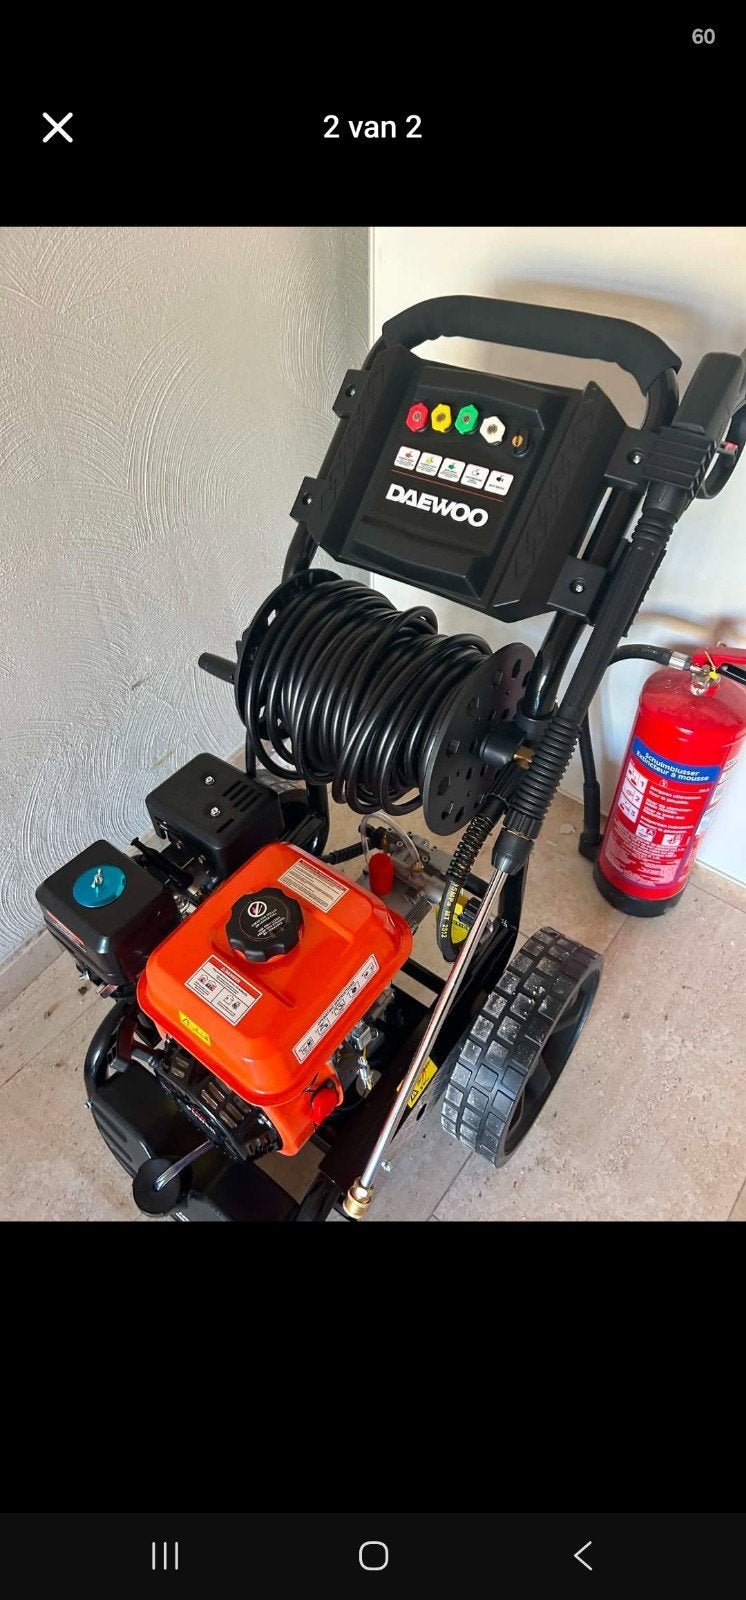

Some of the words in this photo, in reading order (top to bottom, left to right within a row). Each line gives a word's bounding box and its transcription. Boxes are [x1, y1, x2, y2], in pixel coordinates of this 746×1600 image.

[385, 483, 489, 527] DAEWOO
[636, 750, 669, 775] Extincteur
[678, 774, 710, 782] mousse
[645, 752, 700, 776] Schuimblusser
